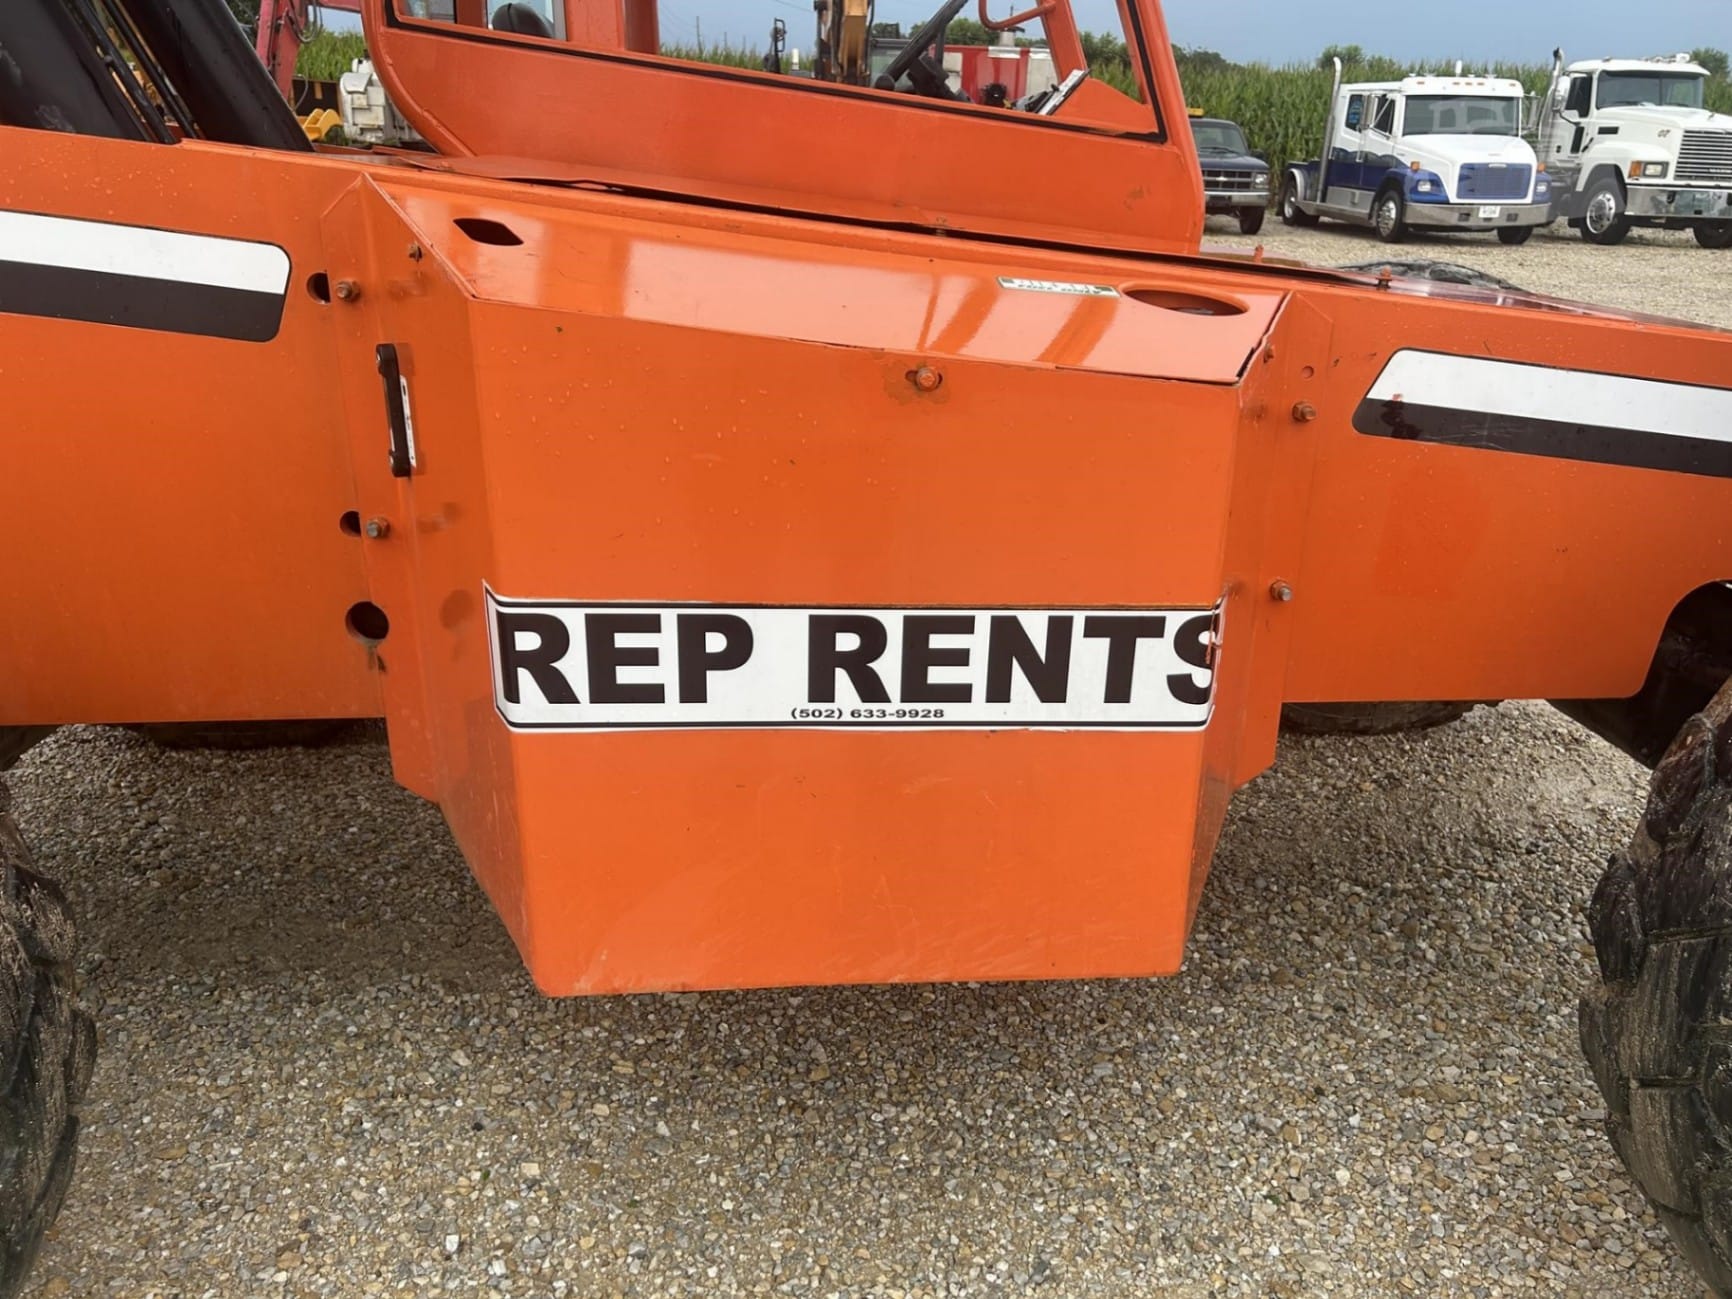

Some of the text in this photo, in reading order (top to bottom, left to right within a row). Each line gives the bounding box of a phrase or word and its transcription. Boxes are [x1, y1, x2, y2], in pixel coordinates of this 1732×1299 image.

[496, 609, 1220, 705] REP RENTS
[791, 707, 945, 719] (502) 633-9928
